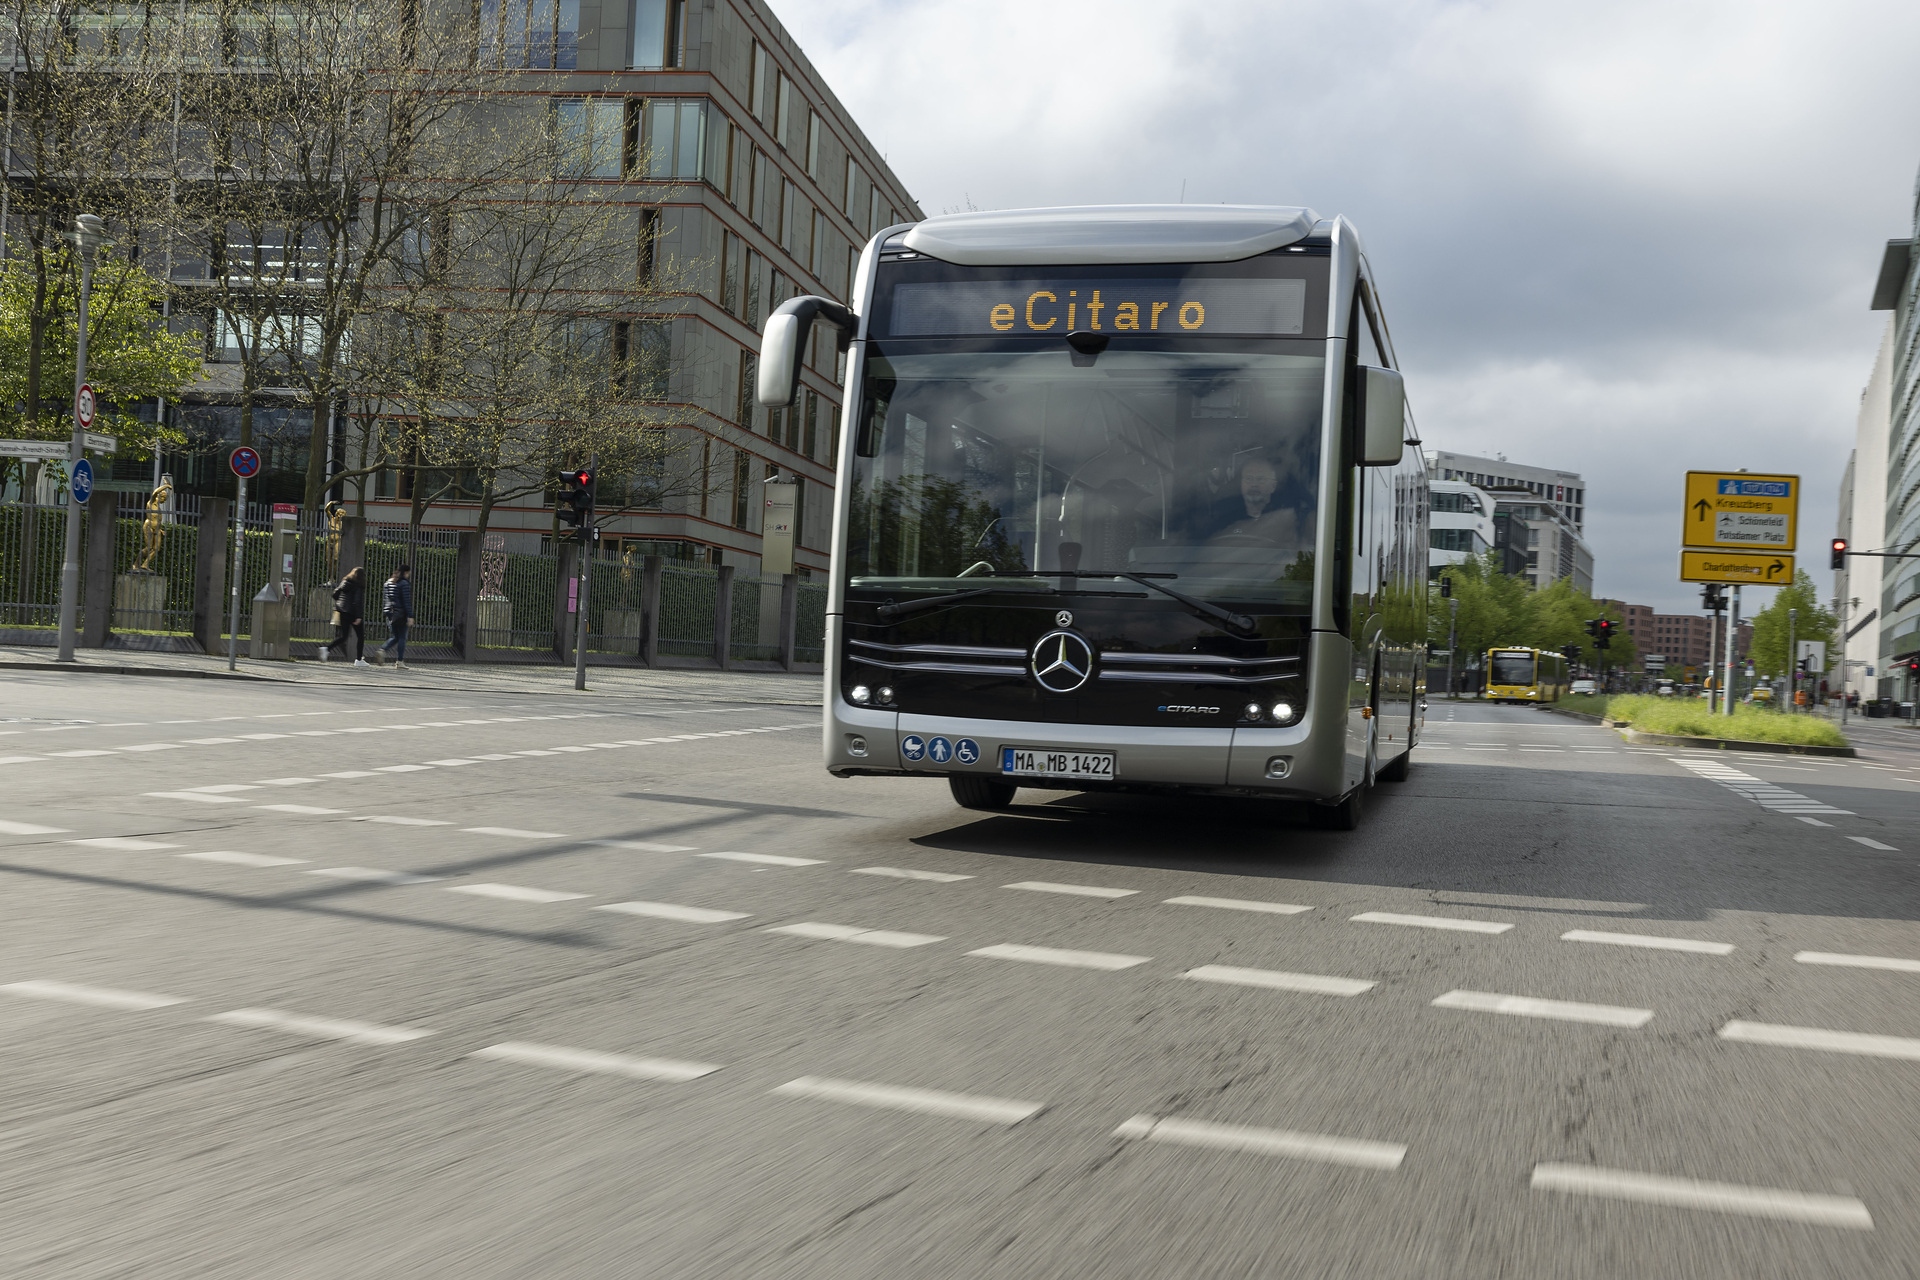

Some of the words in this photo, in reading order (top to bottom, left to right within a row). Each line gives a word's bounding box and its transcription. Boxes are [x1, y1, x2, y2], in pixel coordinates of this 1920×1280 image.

[990, 290, 1205, 331] eCitaro
[81, 395, 92, 416] 30
[1716, 498, 1773, 511] Kreuzberg
[1738, 515, 1784, 526] Schönefeld
[1718, 530, 1761, 541] Potsdamer
[1764, 532, 1785, 542] Platz
[1015, 752, 1035, 771] MA
[1047, 753, 1067, 772] MB
[1071, 755, 1111, 774] 1422
